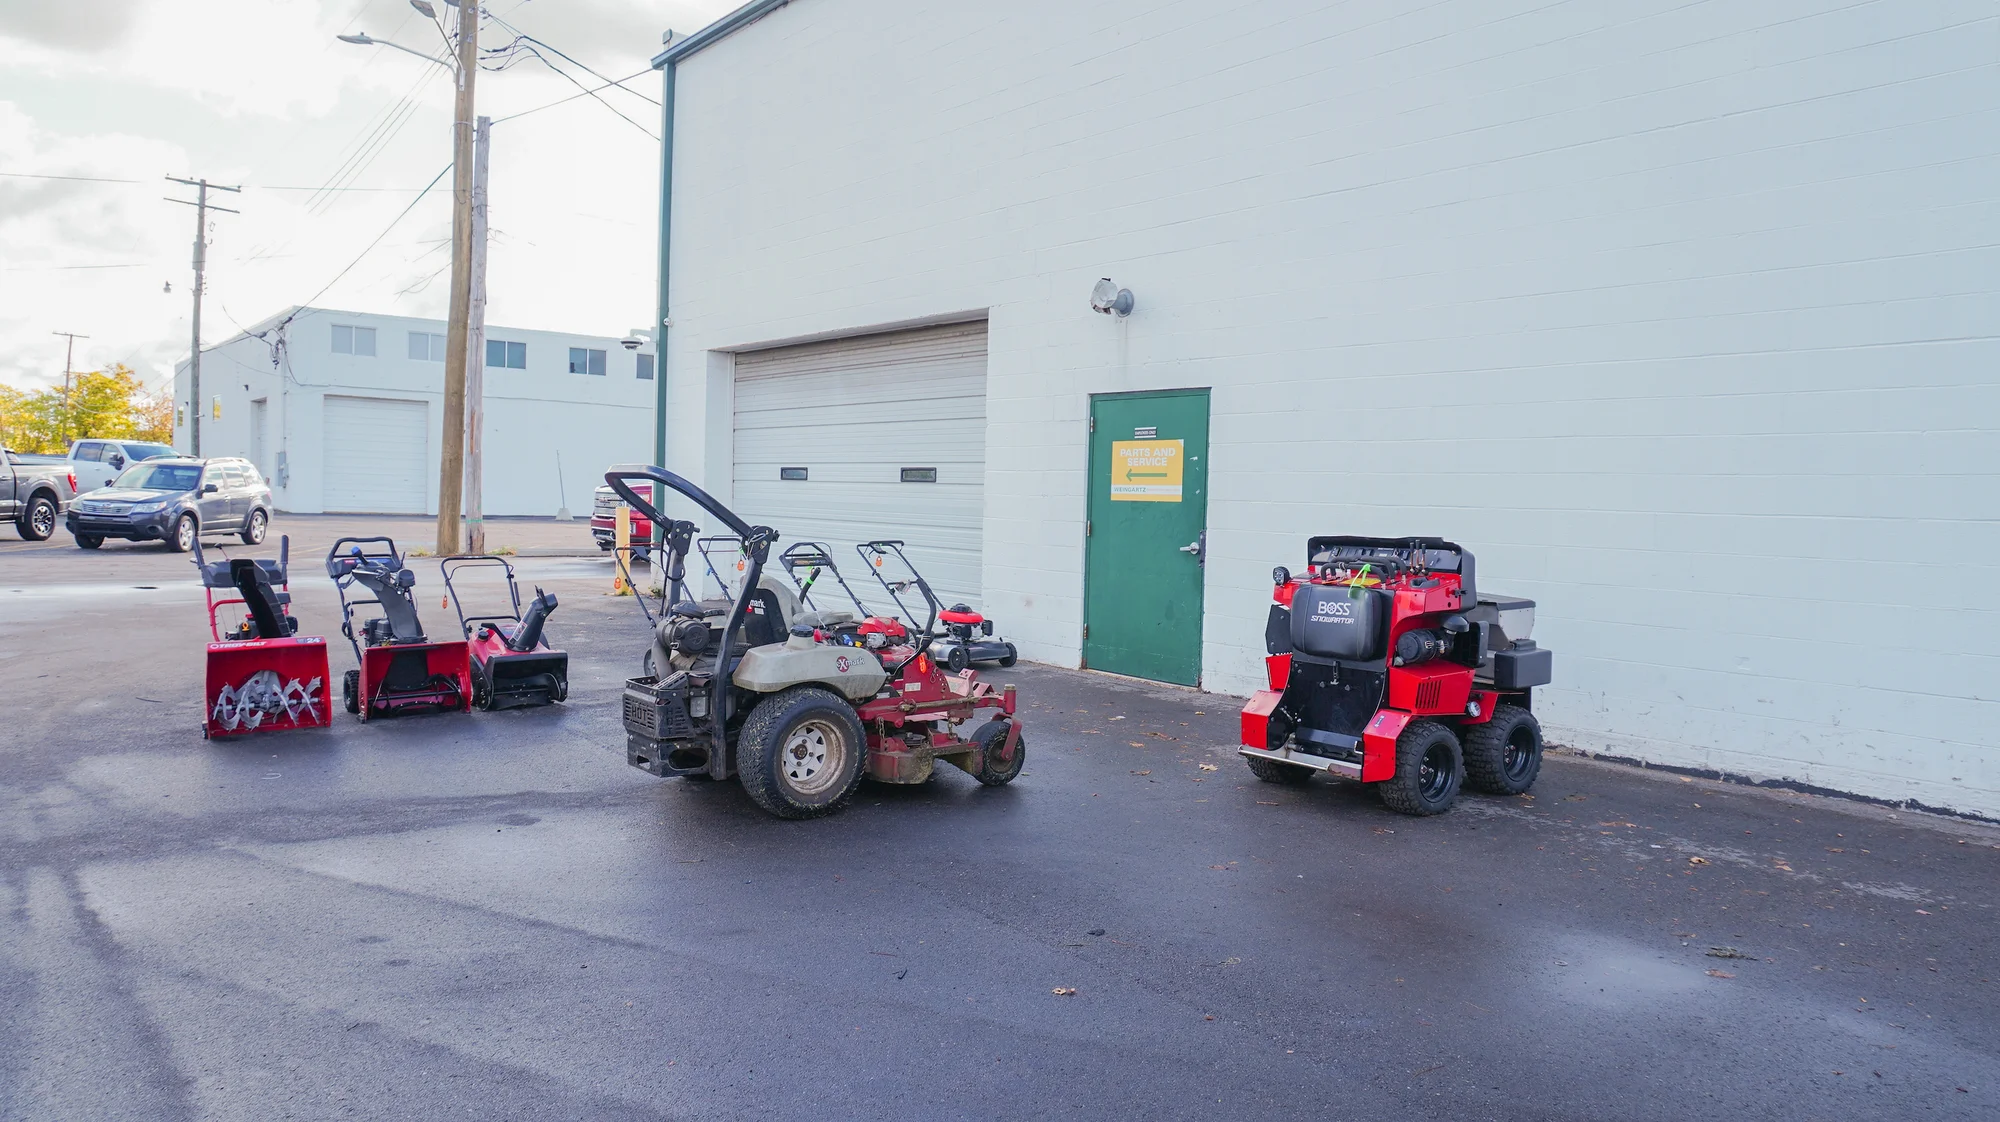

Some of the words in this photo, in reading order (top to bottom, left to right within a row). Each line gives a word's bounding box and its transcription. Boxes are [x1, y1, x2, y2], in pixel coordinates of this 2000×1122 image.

[1120, 448, 1150, 456] PARTS
[1153, 448, 1176, 456] AND
[1127, 457, 1168, 466] SERVICE
[1318, 601, 1351, 615] BOSS
[1311, 615, 1355, 624] SNOWRATOR
[219, 641, 268, 649] TROY-BILT
[631, 704, 648, 721] HOT
